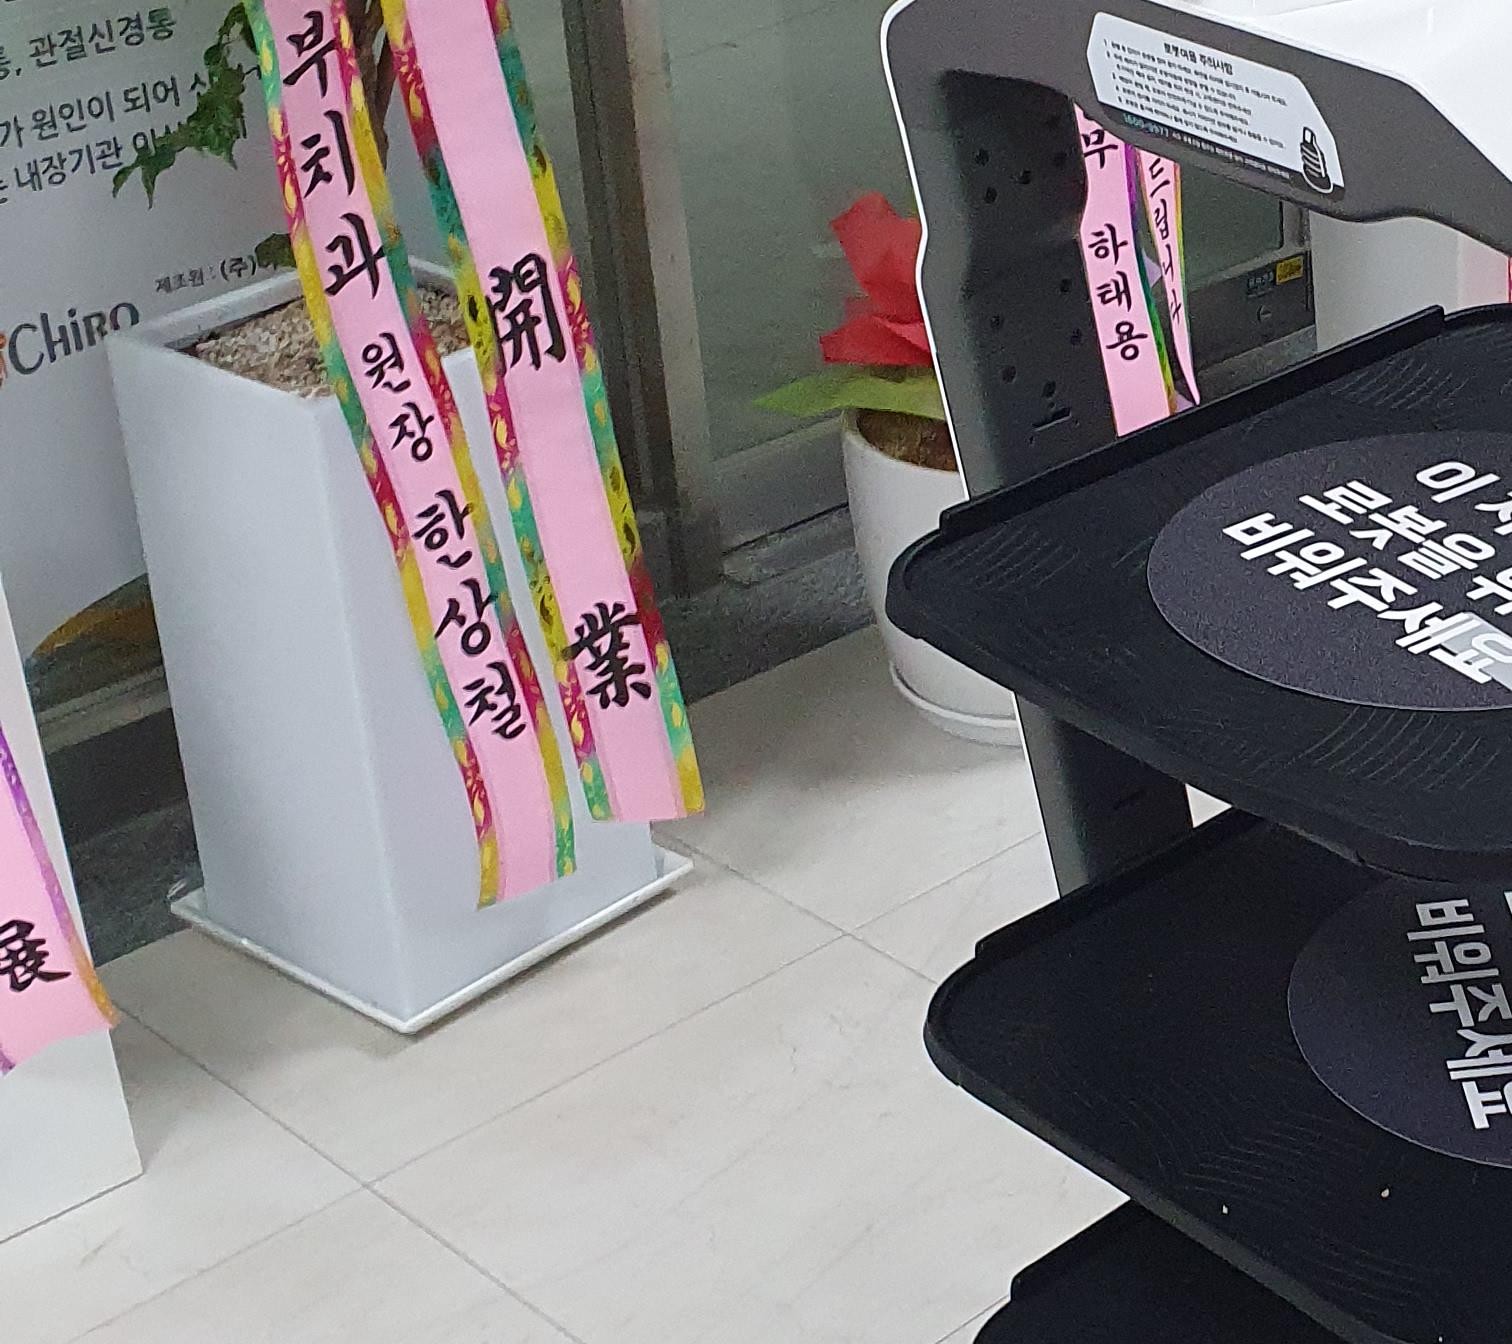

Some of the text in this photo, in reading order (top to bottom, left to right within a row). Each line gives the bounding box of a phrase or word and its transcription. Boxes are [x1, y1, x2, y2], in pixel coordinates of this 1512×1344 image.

[31, 92, 114, 130] 원인이
[123, 74, 183, 113] 되어
[15, 138, 123, 191] 내장기관
[1088, 223, 1148, 360] 하태용
[1416, 461, 1500, 504] 이
[361, 332, 434, 462] 원장
[413, 489, 525, 739] 한상철
[1299, 480, 1495, 579] 로봇을
